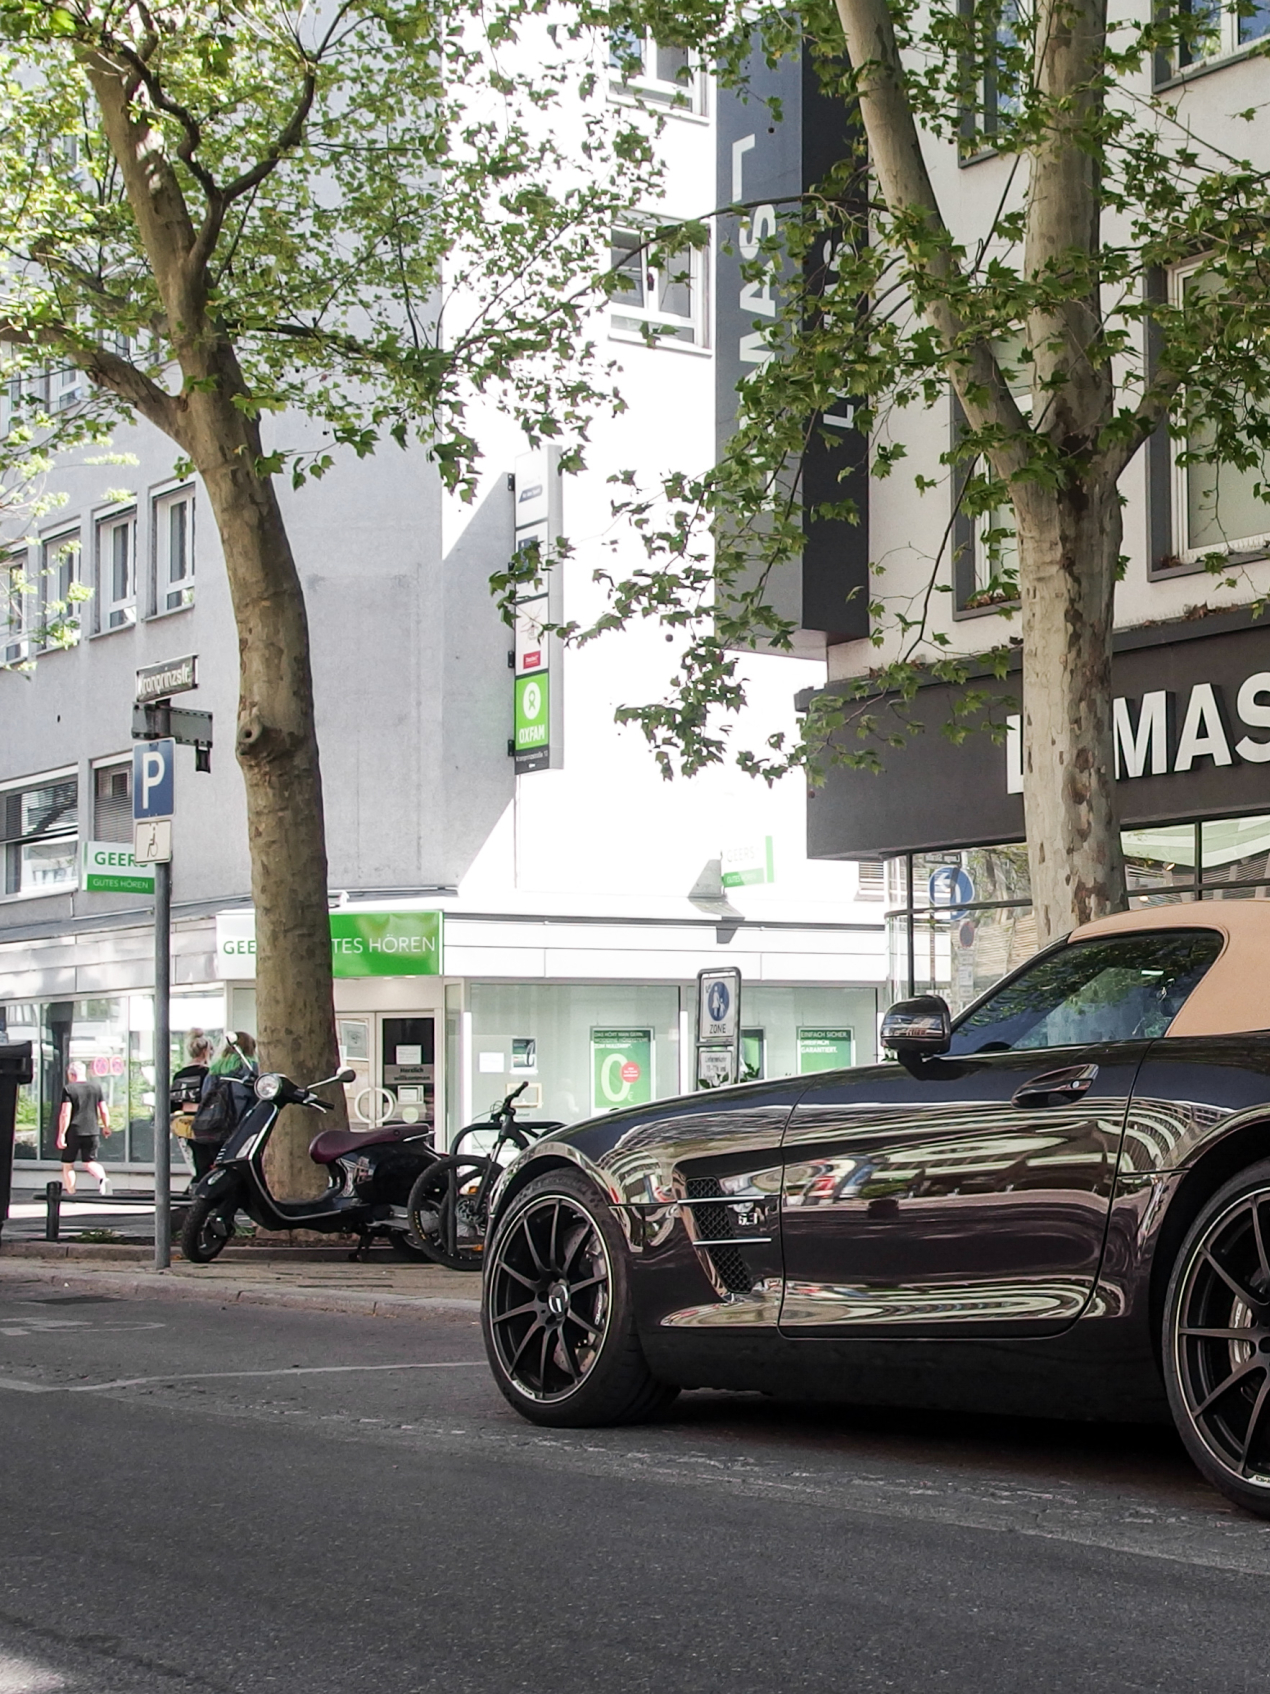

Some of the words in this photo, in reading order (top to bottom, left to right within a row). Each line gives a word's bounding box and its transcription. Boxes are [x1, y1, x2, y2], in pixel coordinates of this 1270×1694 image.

[519, 724, 545, 744] OXFAM
[142, 751, 165, 810] P
[93, 878, 119, 888] GUTES
[120, 877, 149, 889] HÖREN
[223, 940, 256, 955] GEE
[331, 938, 363, 954] TES
[369, 934, 435, 952] HÖREN
[709, 1023, 726, 1034] ZONE
